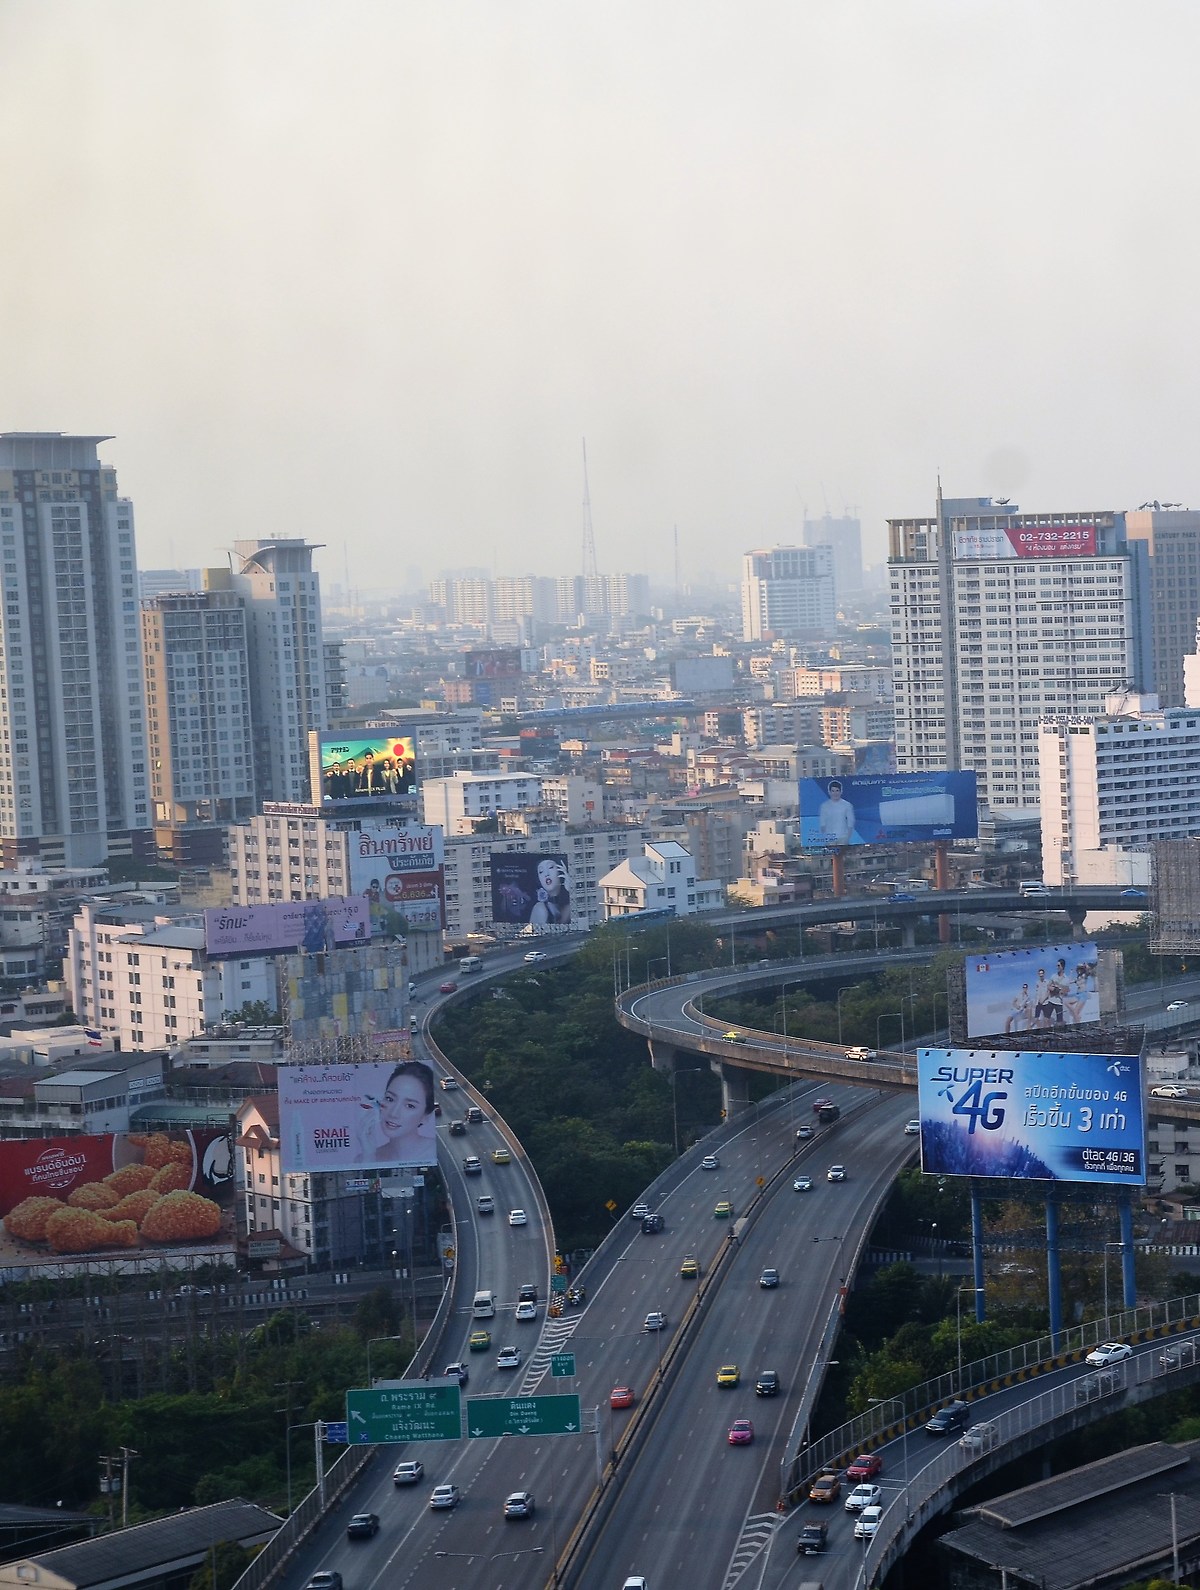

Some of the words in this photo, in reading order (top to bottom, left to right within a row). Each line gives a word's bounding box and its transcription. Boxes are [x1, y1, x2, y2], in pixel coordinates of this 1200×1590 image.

[1019, 531, 1090, 542] 02-732-2215
[359, 828, 433, 855] สินทรัพย์
[392, 854, 434, 868] ประกันภัย
[412, 912, 437, 922] 1729
[930, 1066, 1014, 1085] SUPER
[1024, 1083, 1109, 1101] สปีดอีกขั้นของ
[1113, 1090, 1127, 1102] 4G
[952, 1080, 1008, 1135] 4G
[1023, 1102, 1072, 1128] เร็วขึ้น
[1077, 1106, 1093, 1132] 3
[1100, 1107, 1127, 1131] เท่า
[314, 1129, 350, 1139] SNAIL
[314, 1139, 350, 1149] WHITE
[1082, 1148, 1105, 1161] dtac
[510, 1401, 536, 1410] ดินแดง
[392, 1419, 436, 1431] แจ้งวัฒนะ
